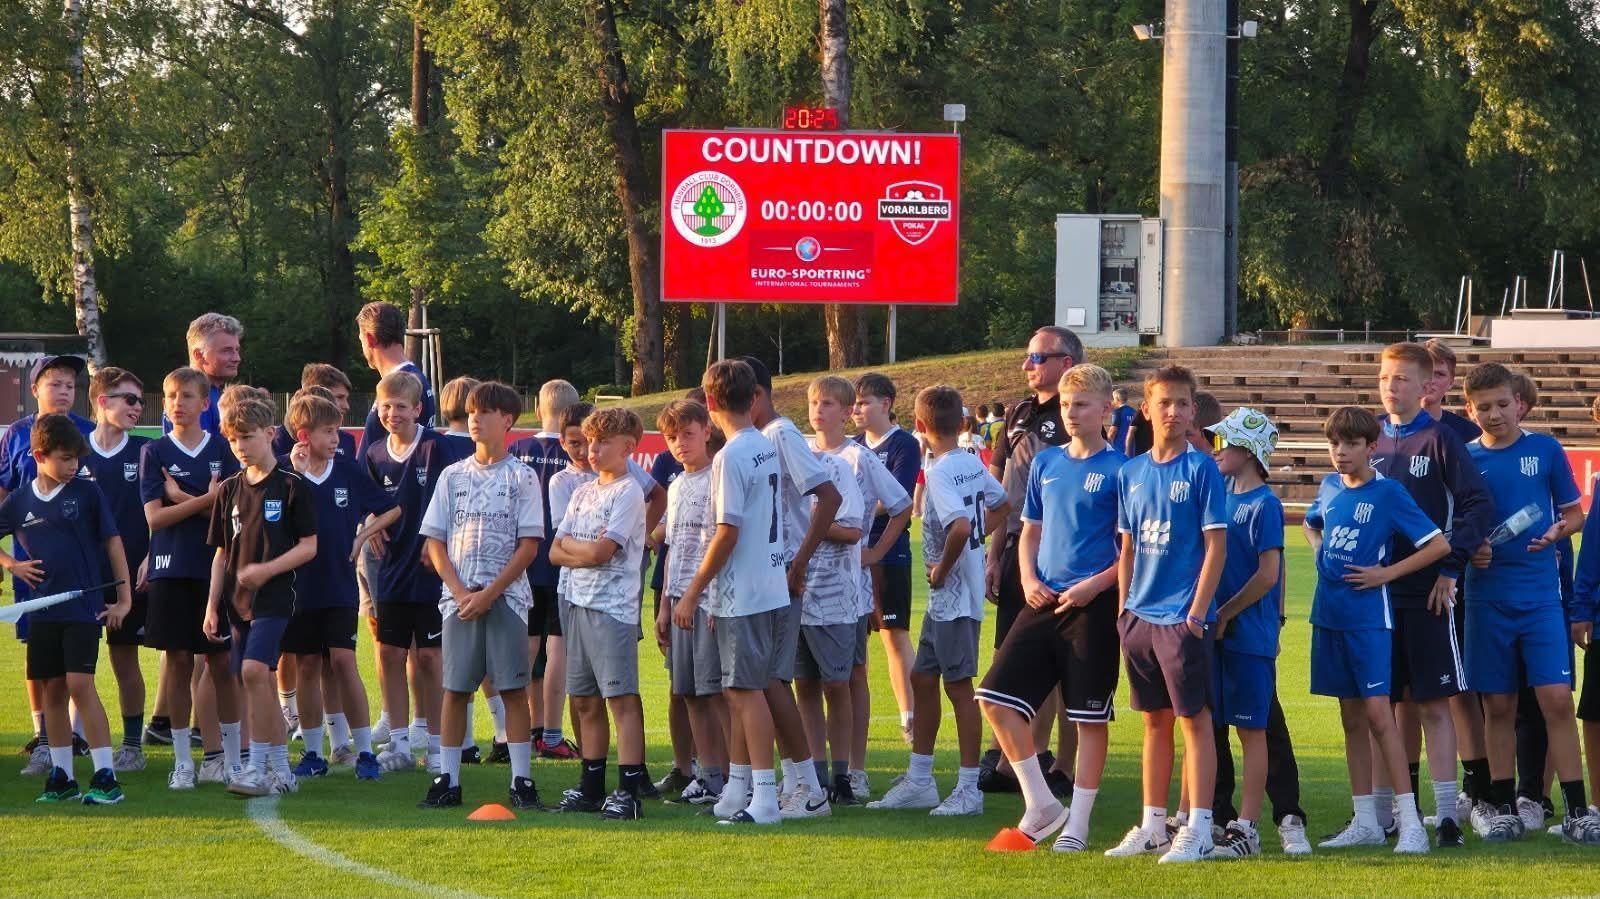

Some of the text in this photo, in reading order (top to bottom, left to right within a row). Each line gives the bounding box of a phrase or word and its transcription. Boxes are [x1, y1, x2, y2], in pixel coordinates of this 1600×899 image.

[701, 137, 921, 165] COUNTDOWN!
[673, 173, 744, 211] FUSSBALL CLUB DORNBIRN
[761, 200, 863, 222] 00:00:00
[881, 205, 948, 215] VORARLBERG
[750, 268, 865, 279] EURO-SPORTRING
[265, 501, 281, 509] TSV
[155, 554, 171, 570] DW
